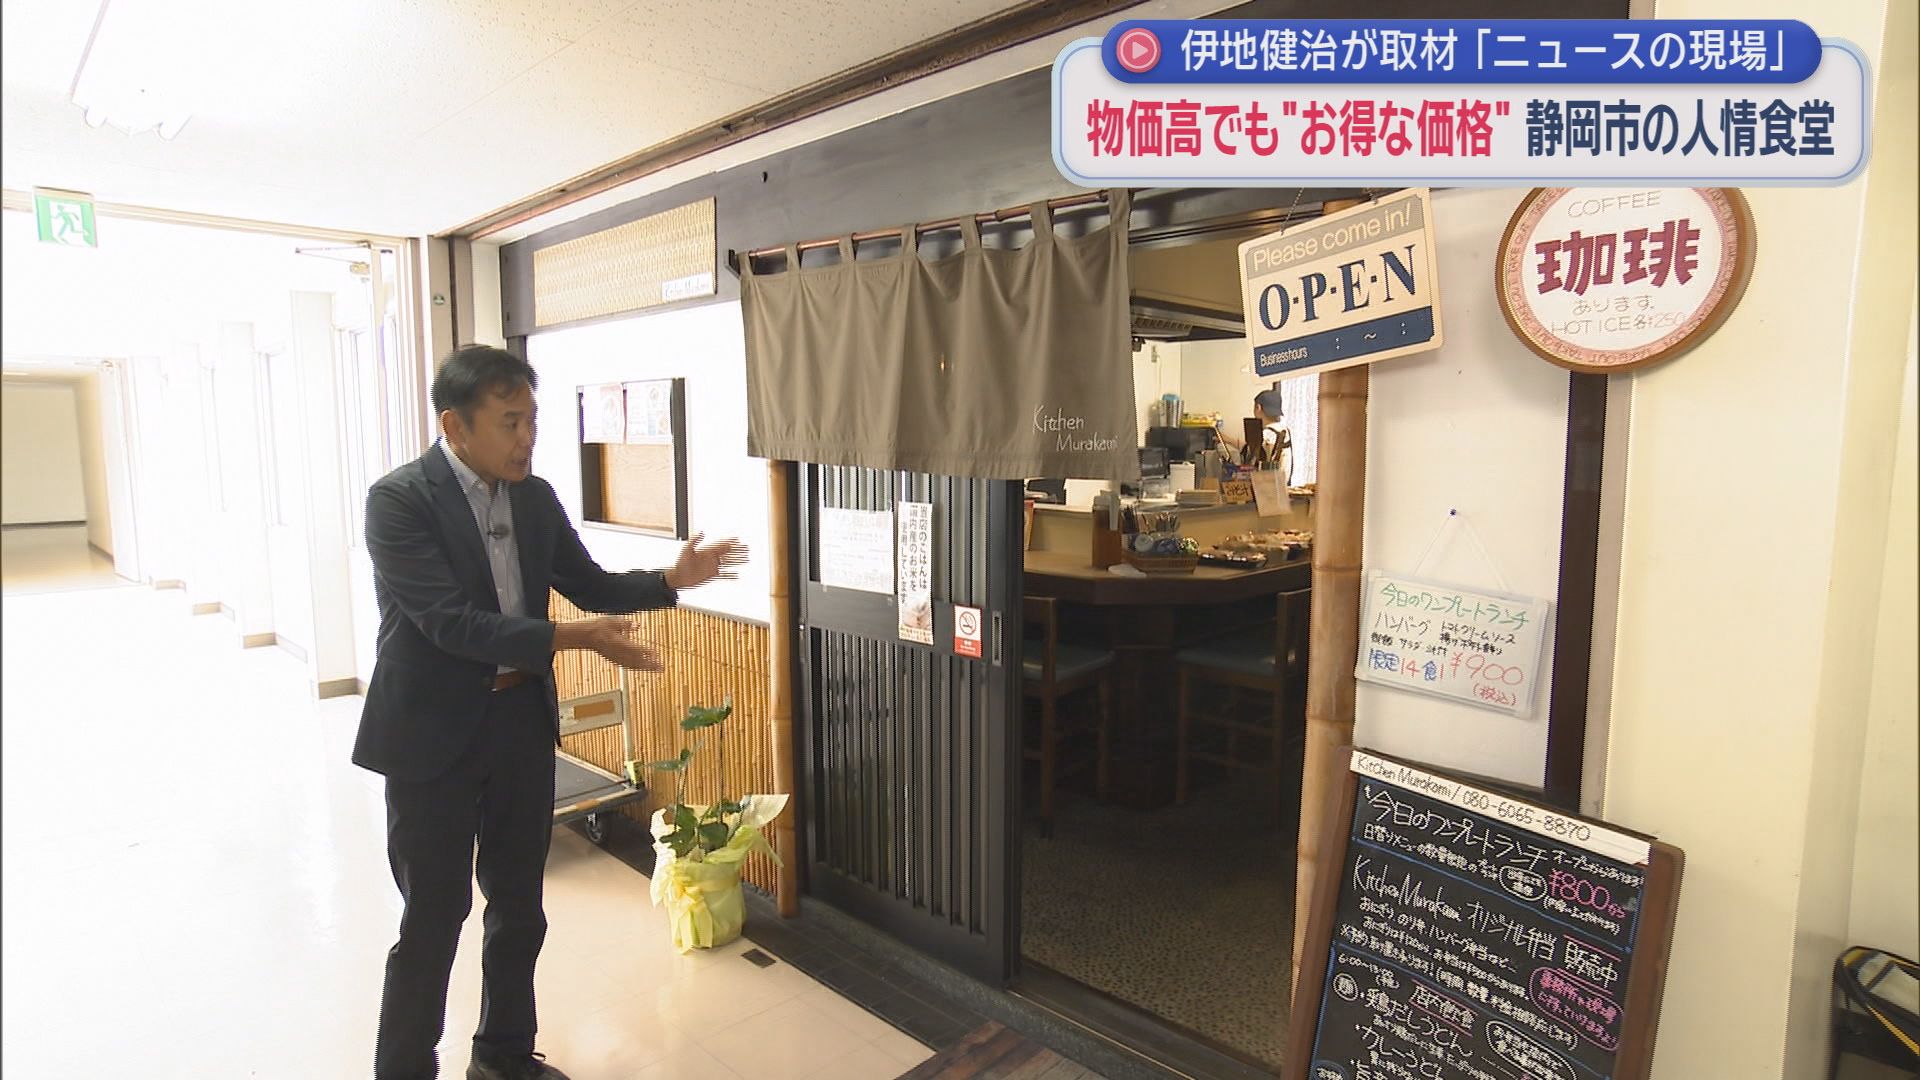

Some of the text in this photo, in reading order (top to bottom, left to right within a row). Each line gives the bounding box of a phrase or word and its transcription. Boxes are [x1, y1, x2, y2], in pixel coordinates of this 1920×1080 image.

[1567, 190, 1662, 218] COFFEE
[1253, 201, 1411, 272] Please come in!
[1535, 218, 1700, 296] 珈琲
[1551, 318, 1593, 337] HOT
[1598, 315, 1632, 333] ICE
[1032, 404, 1084, 435] Kitchen
[1056, 431, 1119, 452] Murakami
[1375, 610, 1432, 636] ハンバーグ
[1381, 582, 1529, 630] 今日のワンプレートランチ
[1357, 755, 1396, 781] Kitchen
[1462, 790, 1592, 842] 080-6065-8870
[1368, 790, 1548, 871] 今日のワンプレートランチ
[1564, 940, 1619, 988] 販売中
